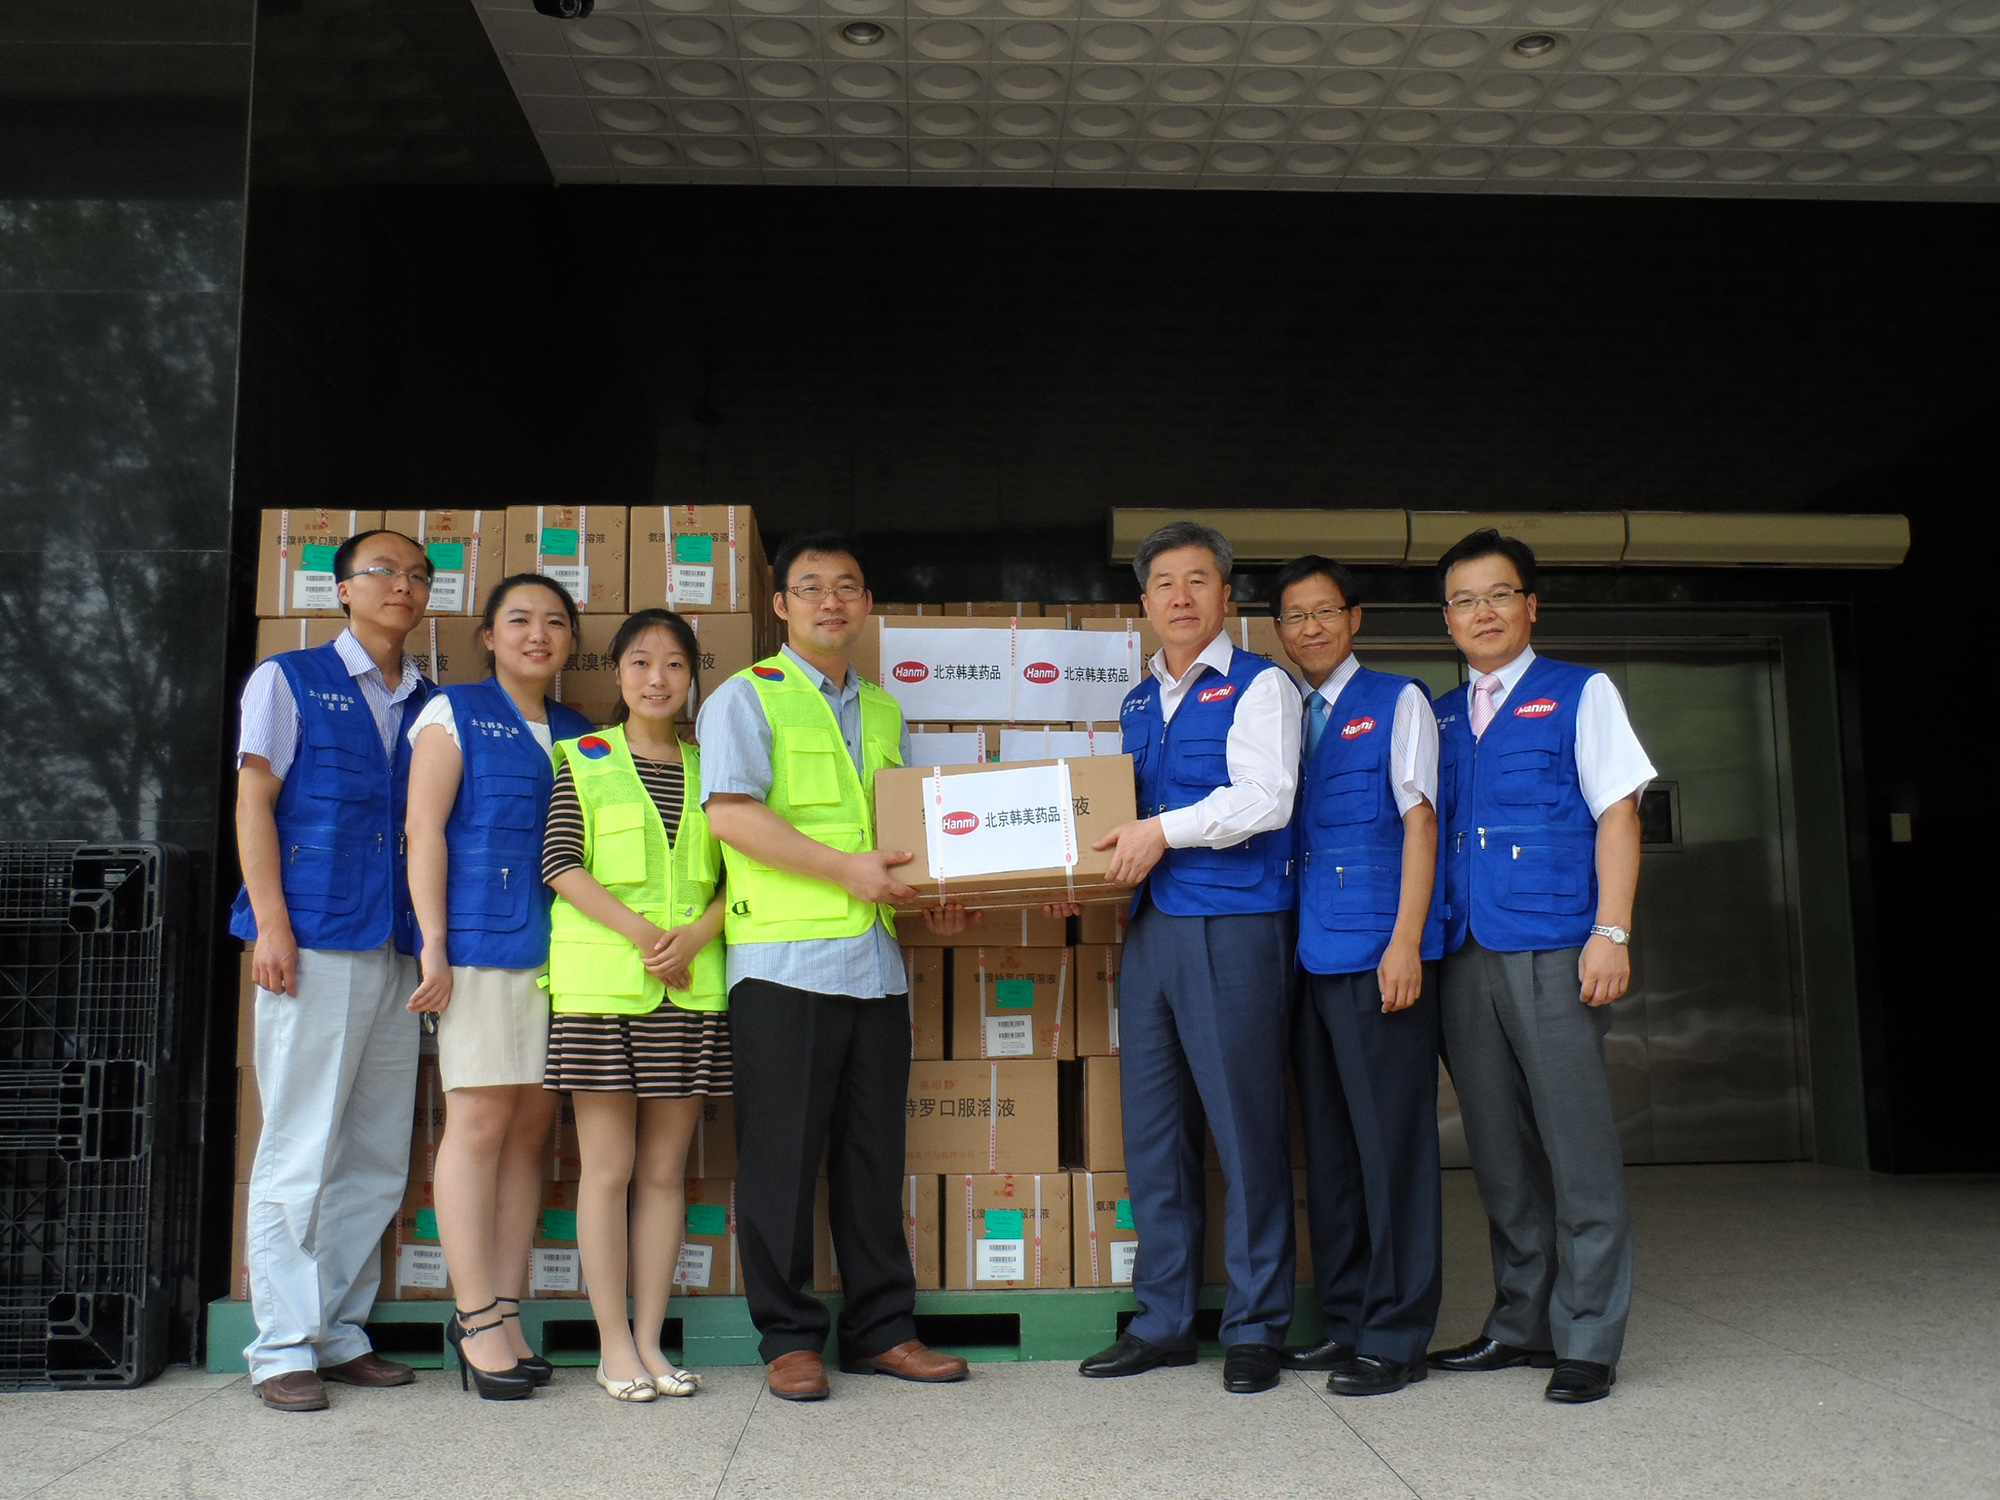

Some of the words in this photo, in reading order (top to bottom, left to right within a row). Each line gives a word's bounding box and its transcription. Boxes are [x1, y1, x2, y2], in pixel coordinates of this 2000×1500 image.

[895, 667, 926, 679] Hanmi
[933, 664, 1001, 681] 北京韩美药品
[1026, 667, 1057, 679] Hanmi
[1064, 666, 1129, 683] 北京韩美药品
[1201, 686, 1232, 702] Hmi
[943, 816, 976, 831] Hanmi
[984, 806, 1061, 829] 北京韩美药品
